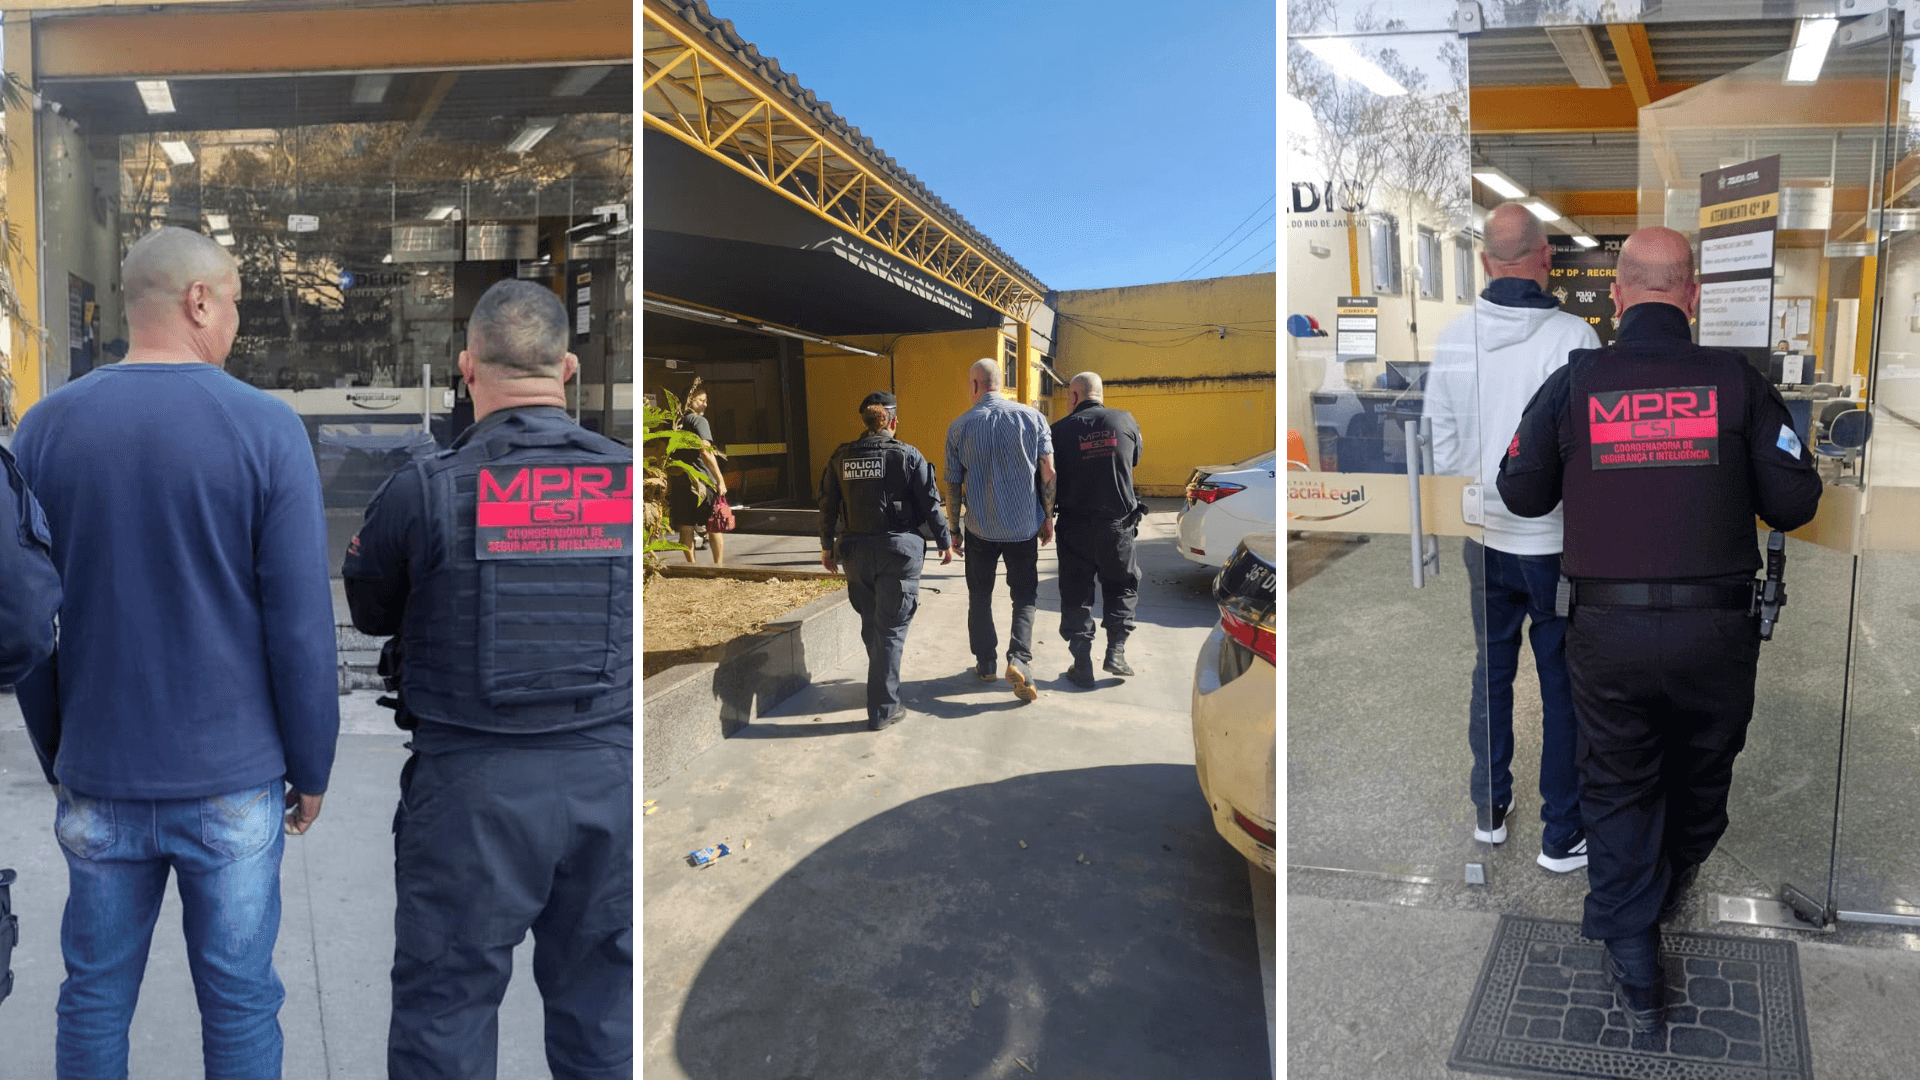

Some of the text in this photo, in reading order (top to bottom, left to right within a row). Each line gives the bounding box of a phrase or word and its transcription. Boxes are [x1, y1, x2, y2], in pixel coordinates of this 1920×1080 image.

[1710, 204, 1748, 223] ATENDIMENTO
[1305, 220, 1318, 228] RIO
[1320, 220, 1331, 228] DE
[1566, 268, 1580, 277] DP
[1587, 268, 1618, 277] RECRE
[1589, 390, 1717, 423] MPRJ
[1631, 420, 1676, 439] CSI
[1614, 440, 1694, 453] COORDENADORIA DE
[1600, 449, 1710, 464] SEGURANÇA E INTELIGÊNCIA
[844, 460, 881, 470] POLÍCIA
[844, 469, 881, 478] MILITAR
[479, 466, 633, 502] MPRJ
[530, 502, 583, 524] CSI
[506, 526, 604, 540] COORDENADORIA DE
[488, 538, 623, 554] SEGURANÇA E INTELIGÊNCIA
